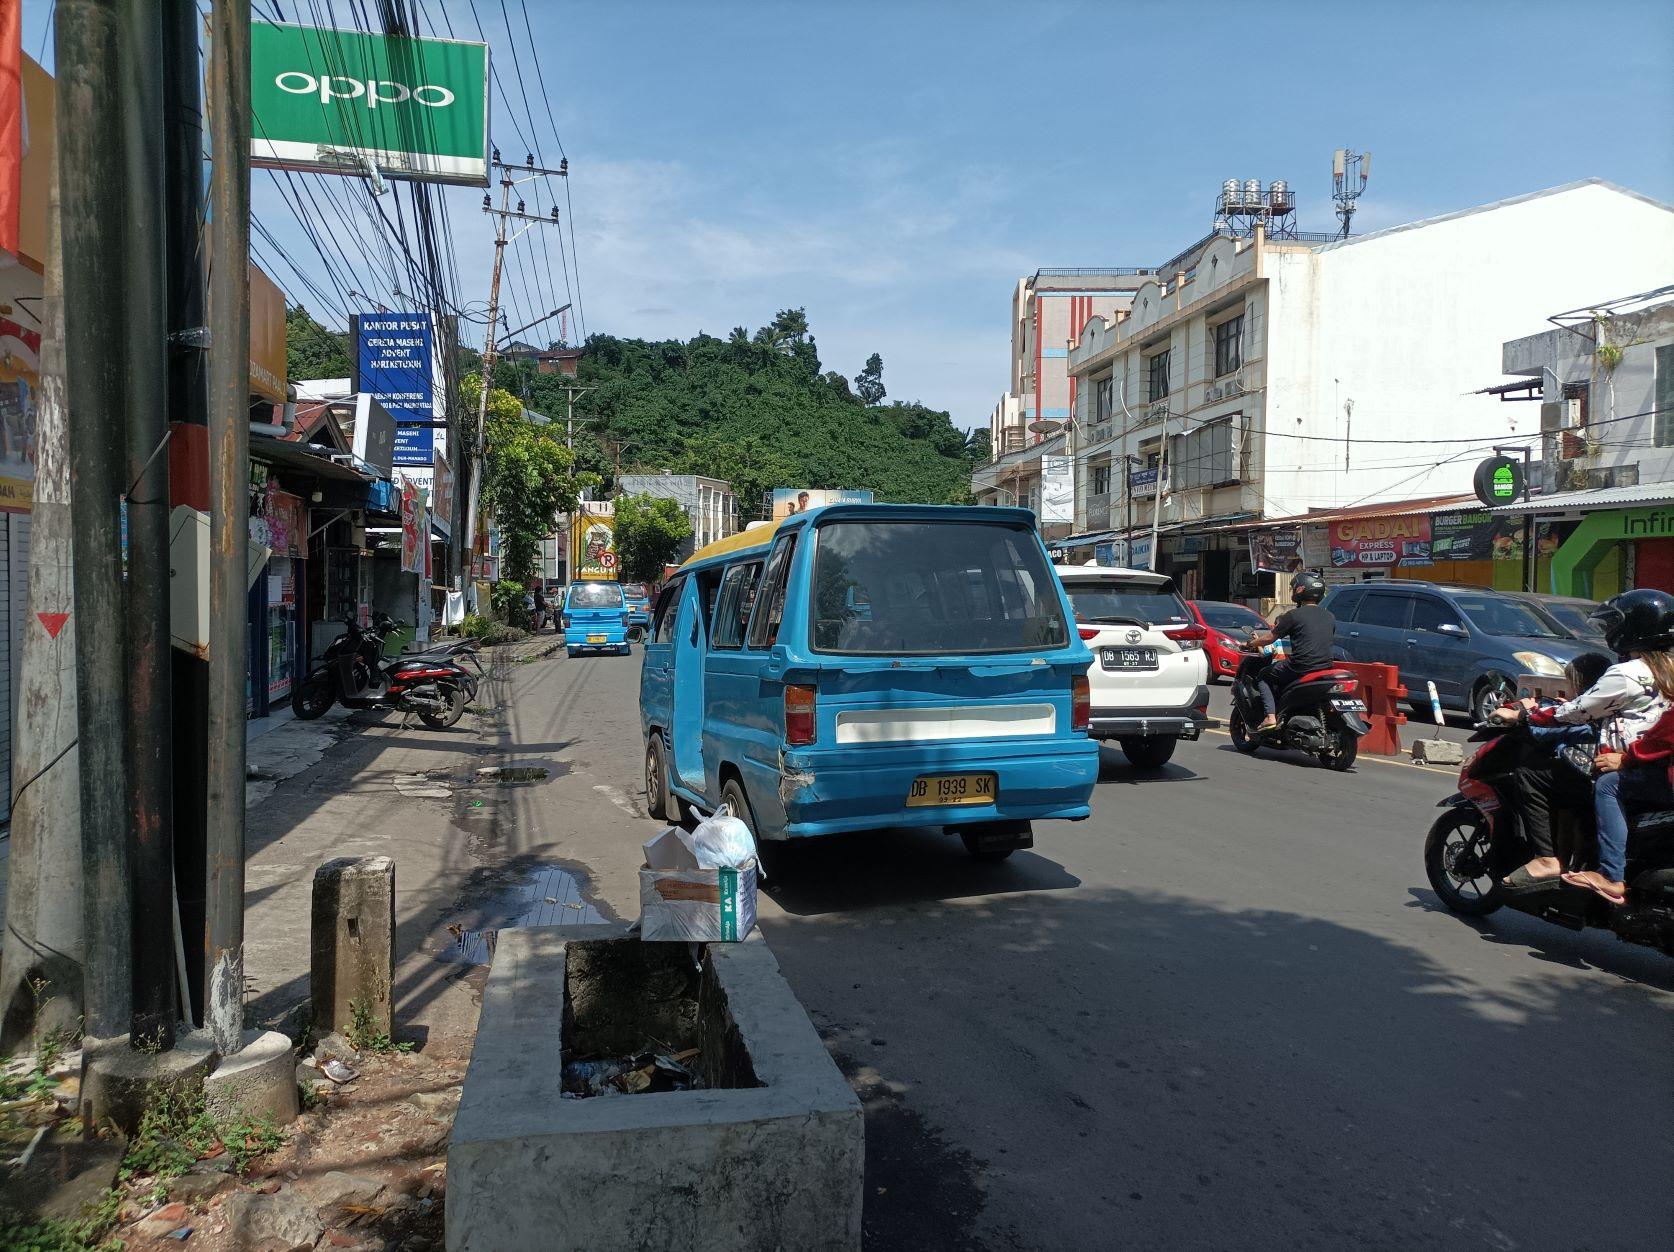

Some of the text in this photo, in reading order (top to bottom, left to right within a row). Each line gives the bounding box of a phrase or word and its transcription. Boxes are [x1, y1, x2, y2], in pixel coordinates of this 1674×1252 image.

[364, 321, 427, 330] KANTOR PUSAT
[381, 348, 411, 357] ADVENT
[1337, 517, 1420, 541] GADAI
[1360, 541, 1395, 549] EXPRESS
[1104, 651, 1115, 661] DB
[1120, 650, 1140, 661] 1565
[911, 778, 991, 797] DB 1939 SK
